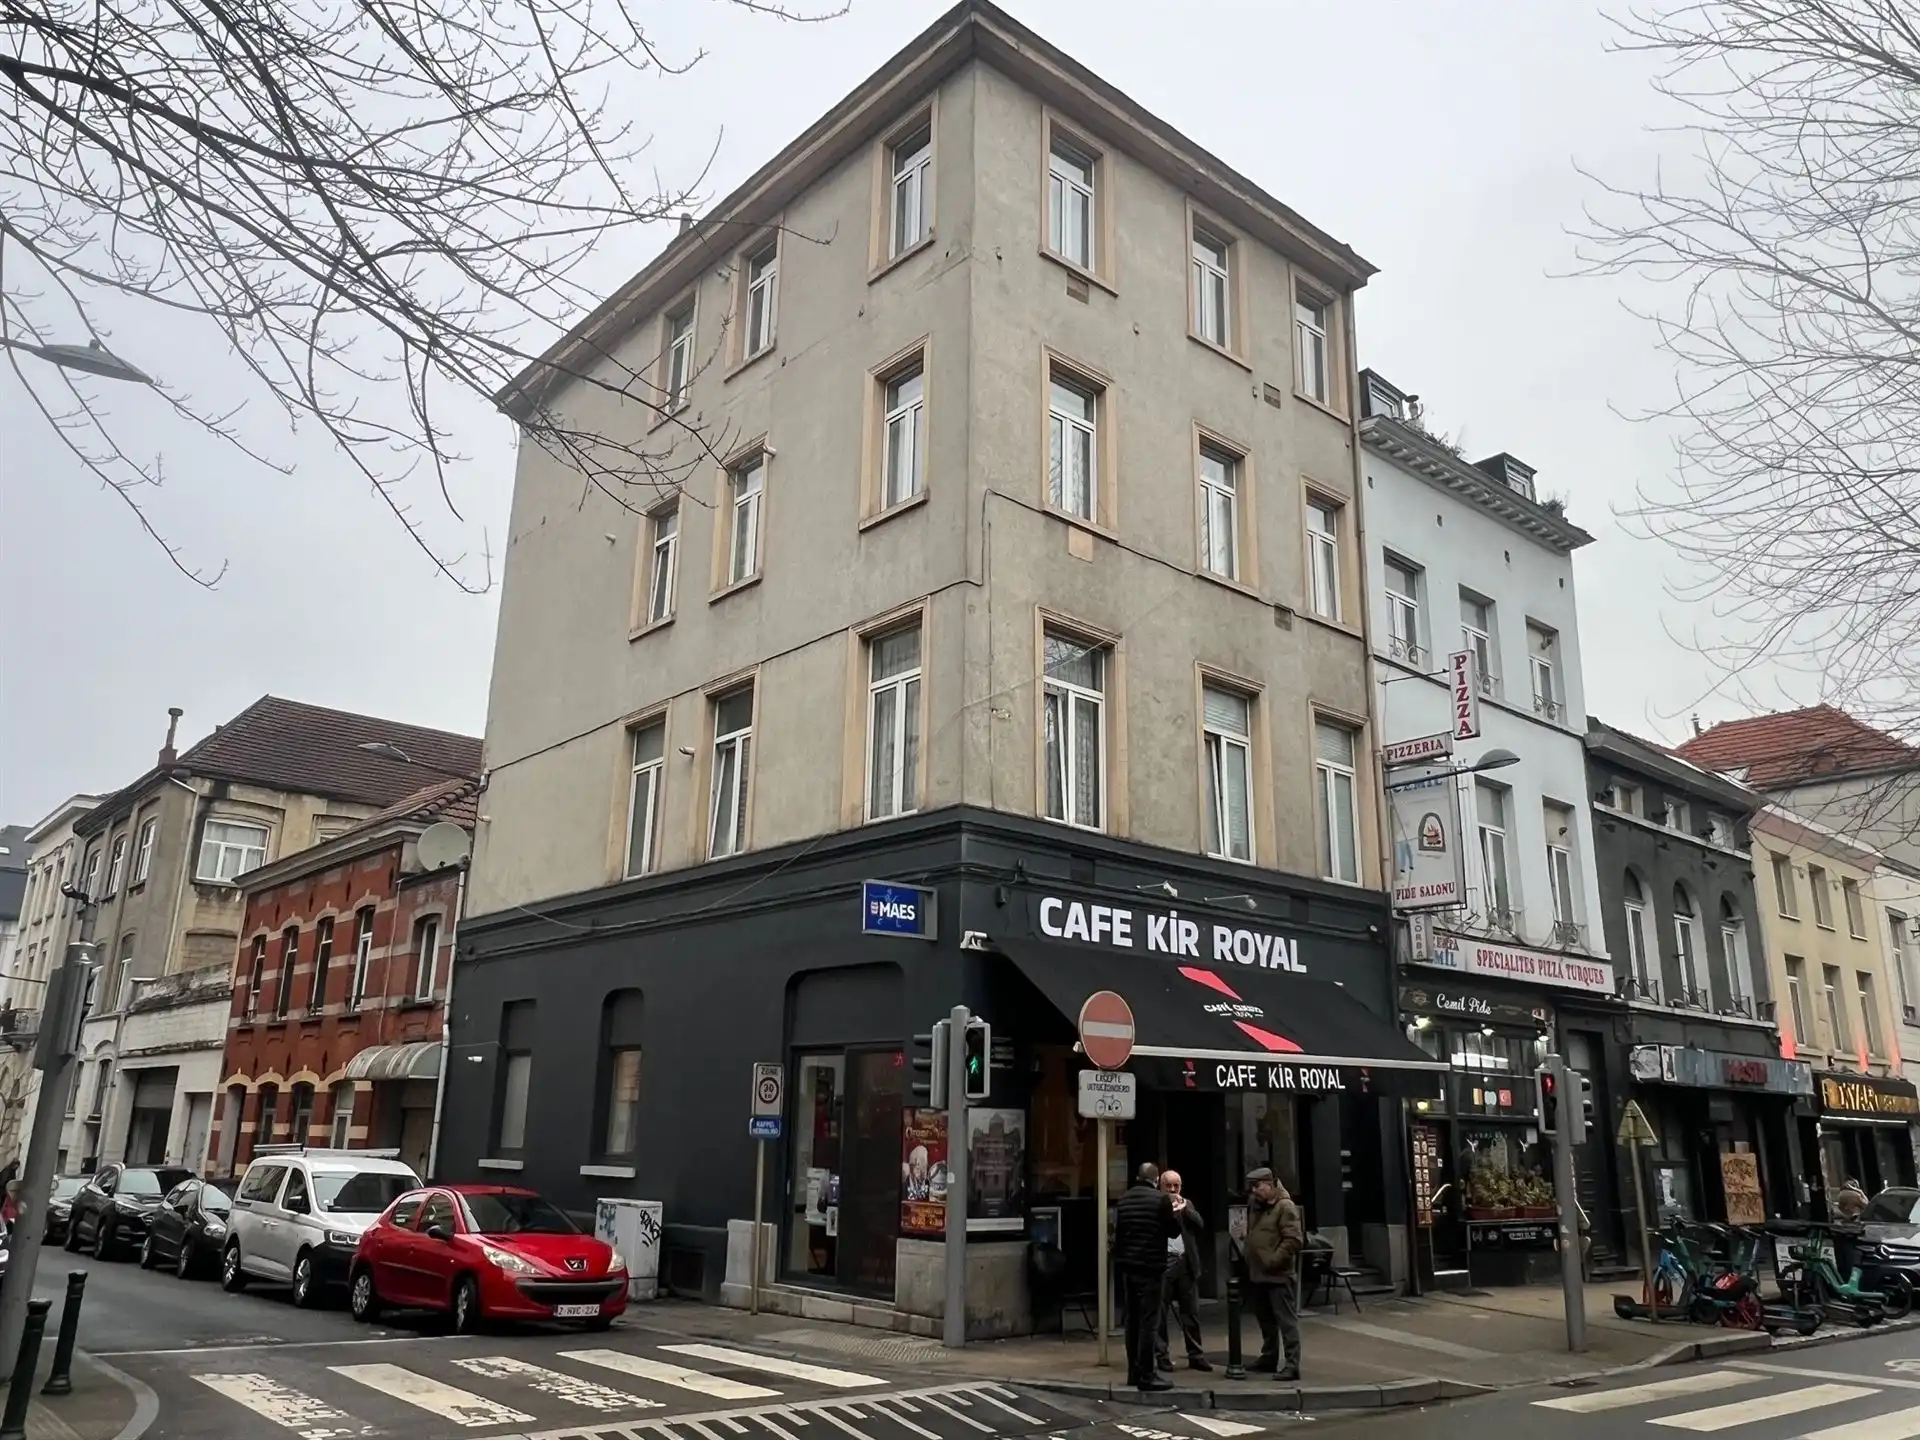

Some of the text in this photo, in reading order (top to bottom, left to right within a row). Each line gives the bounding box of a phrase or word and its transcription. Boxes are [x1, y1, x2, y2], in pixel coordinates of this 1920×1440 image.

[1454, 654, 1473, 736] PIZZA
[1387, 739, 1444, 761] PIZZERIA
[1419, 882, 1455, 898] SALONU
[879, 901, 916, 921] MAES
[1039, 896, 1133, 948] CAFE
[1212, 924, 1307, 974] ROYAL
[1476, 949, 1605, 987] SPECIALITES PIZZA TURQUES
[1436, 993, 1493, 1016] Cemil Pide
[764, 1084, 775, 1093] 30
[1216, 1064, 1257, 1088] CAFE
[1300, 1068, 1346, 1090] ROYAL
